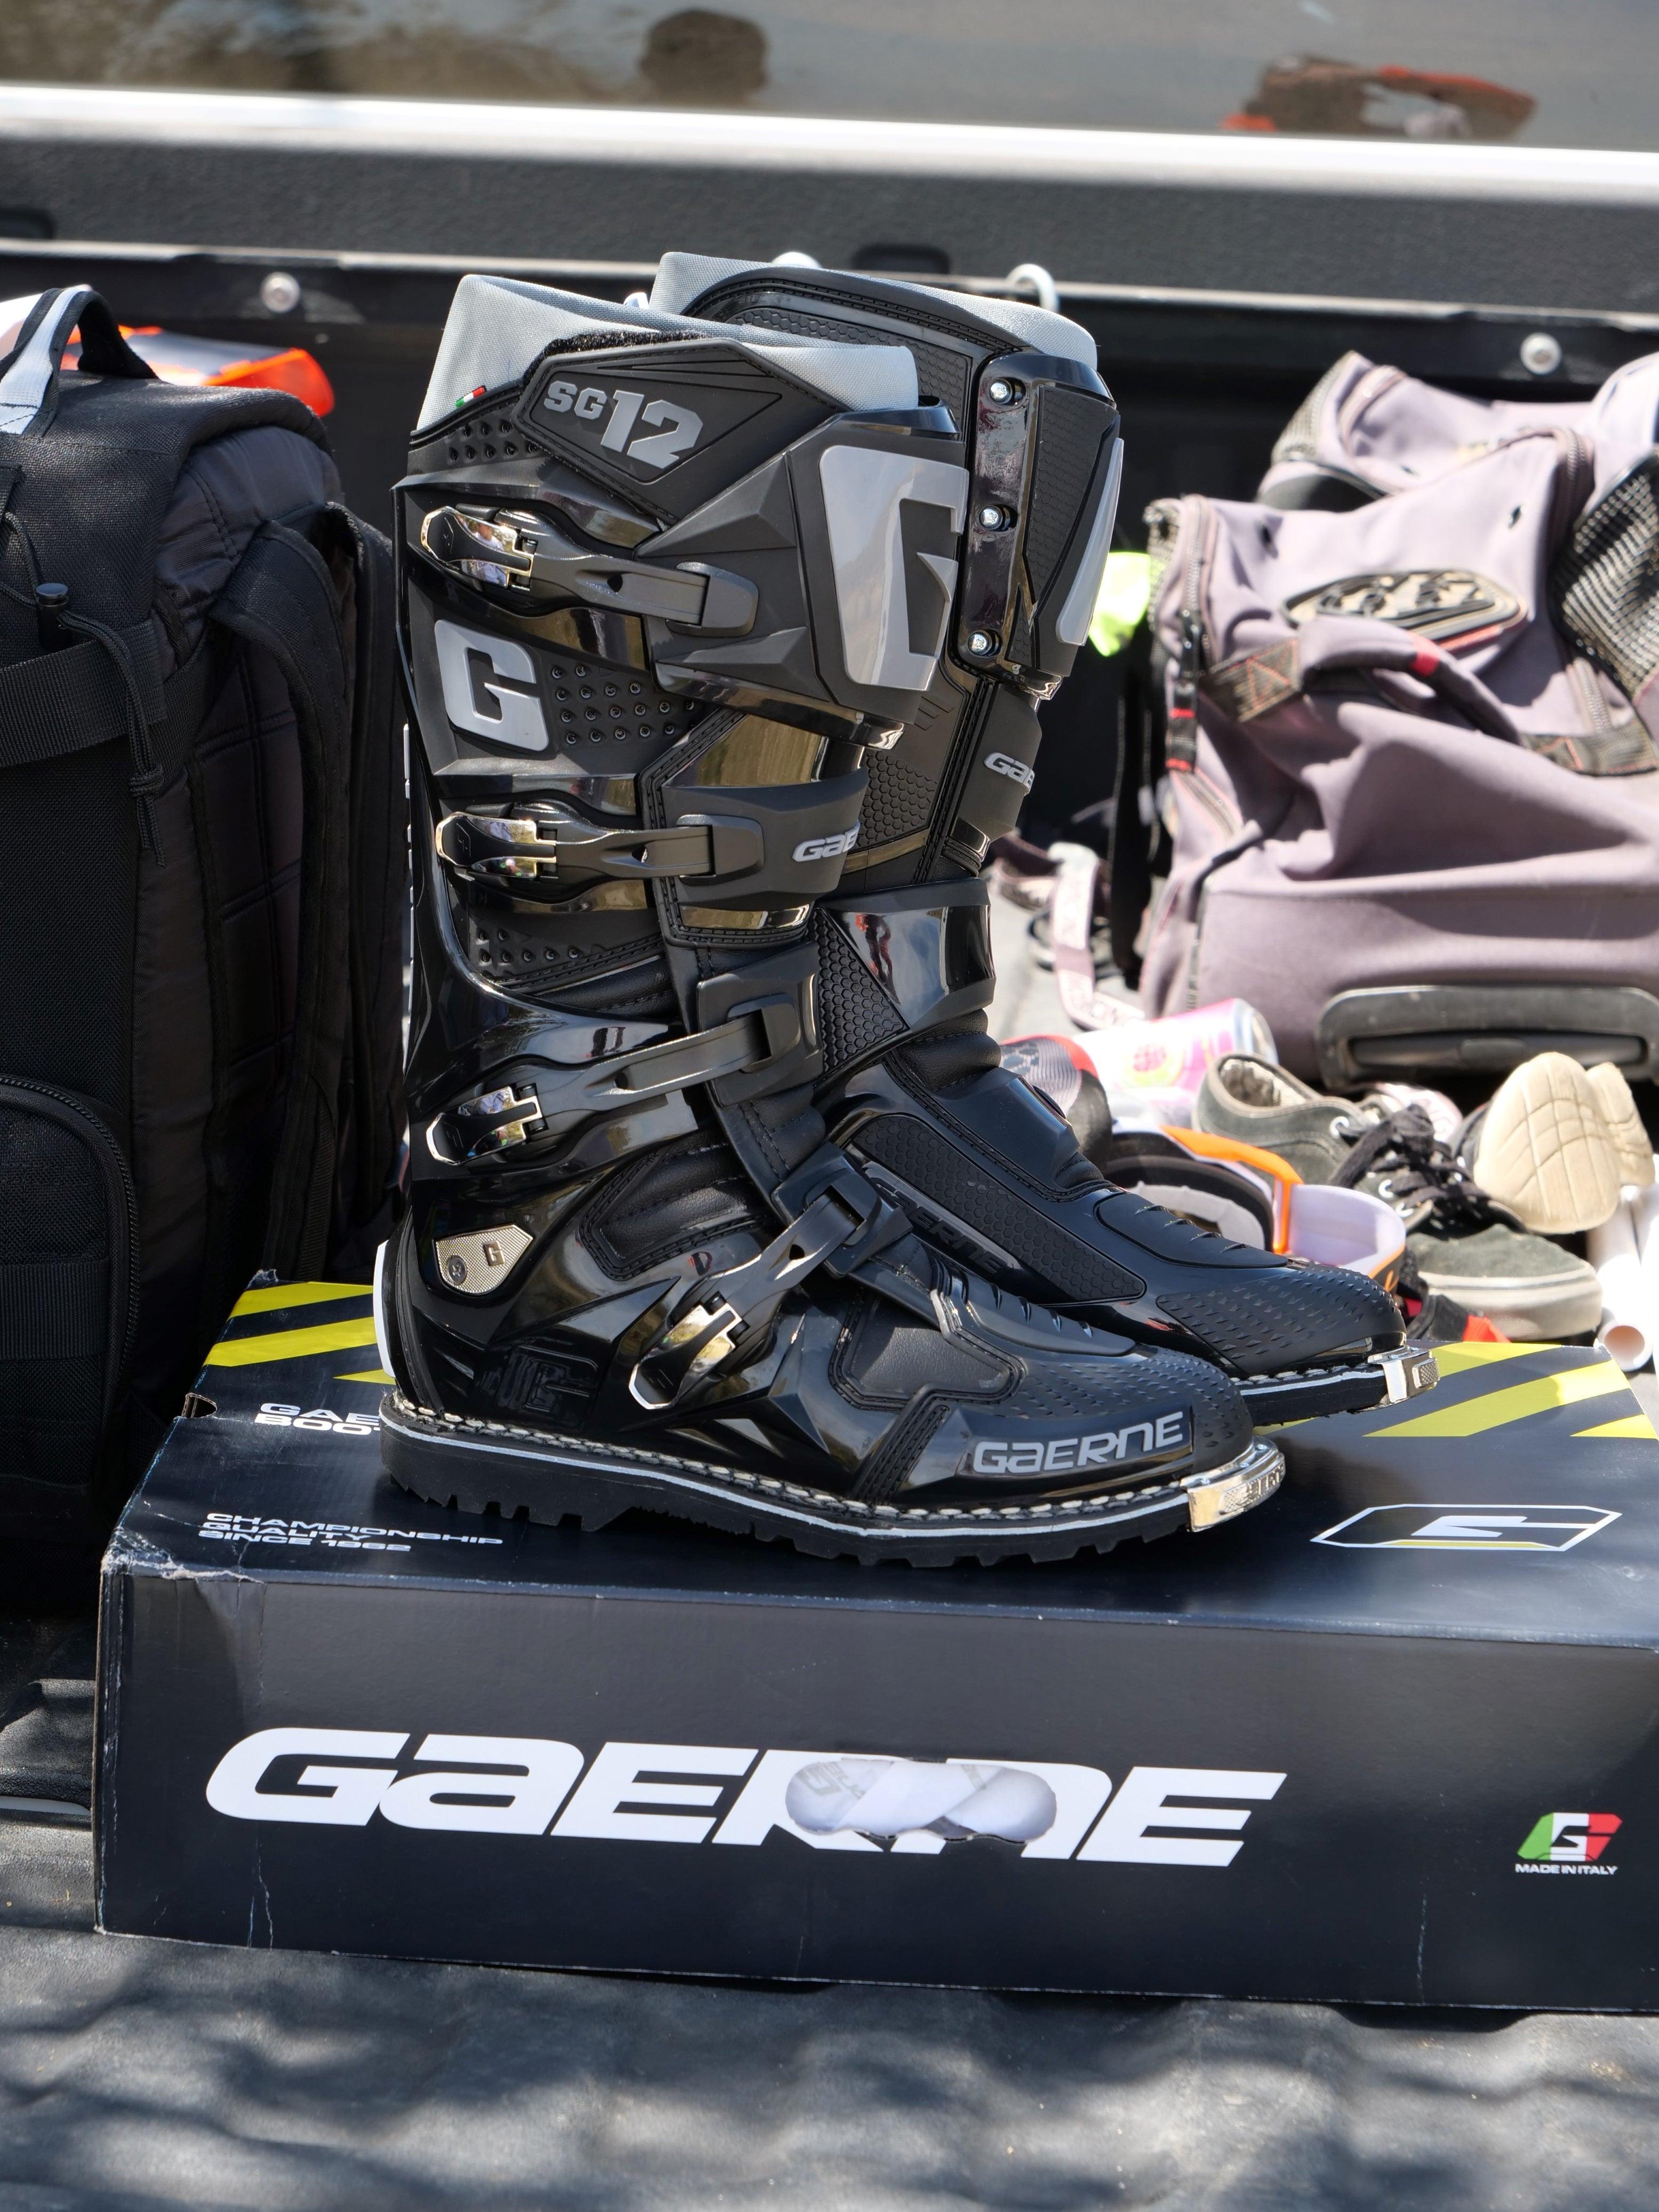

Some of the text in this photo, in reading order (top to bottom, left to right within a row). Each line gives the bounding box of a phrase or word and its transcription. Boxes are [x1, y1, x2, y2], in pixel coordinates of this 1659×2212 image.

[434, 619, 549, 752] G
[254, 1413, 381, 1435] BOO
[202, 1522, 372, 1540] QUALITY
[206, 1513, 504, 1545] CHAMPIONSHIP
[198, 1530, 412, 1552] SINCE 1962
[1515, 1863, 1618, 1875] MADE IN ITALY
